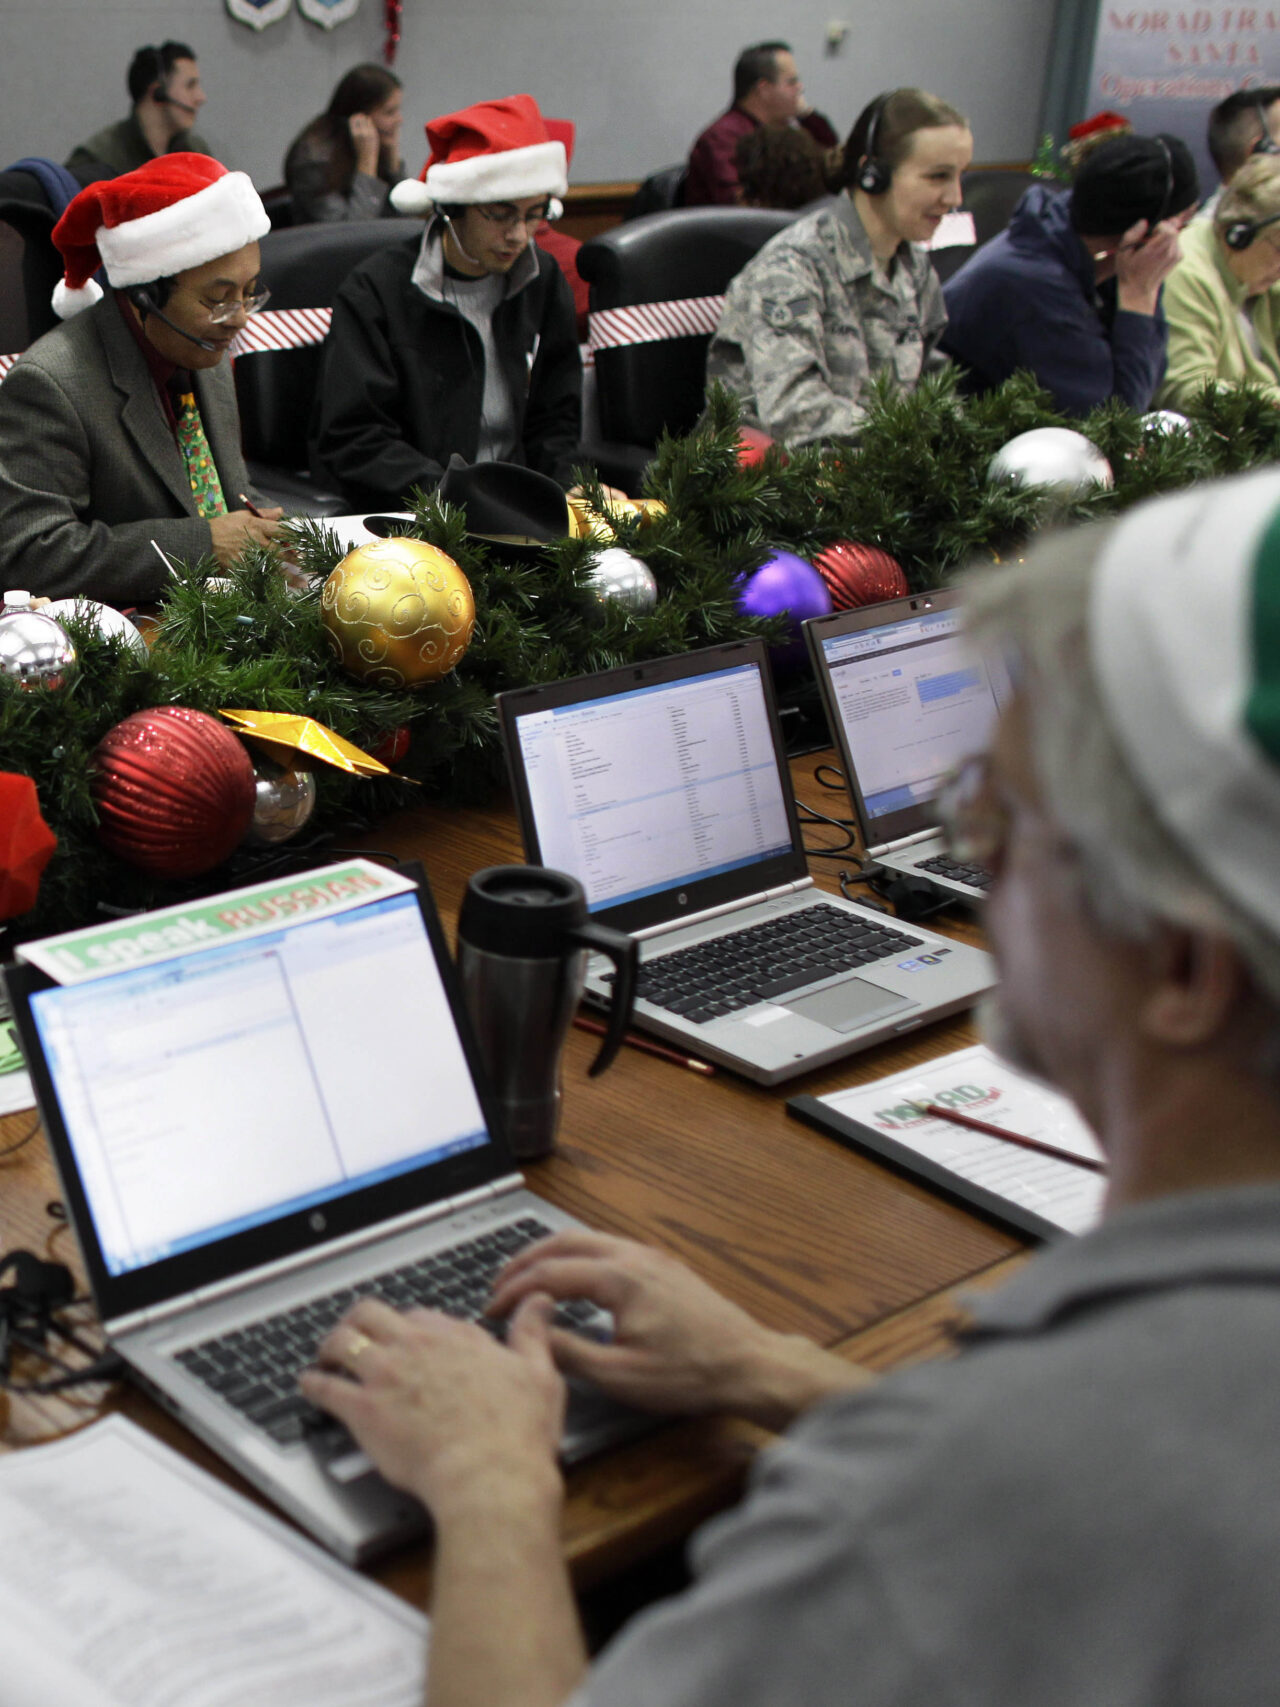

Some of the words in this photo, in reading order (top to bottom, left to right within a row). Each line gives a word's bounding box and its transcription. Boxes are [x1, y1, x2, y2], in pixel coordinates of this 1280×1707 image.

[1106, 8, 1212, 33] NORAD
[1167, 41, 1260, 66] SANTA
[86, 917, 221, 965] speak
[218, 872, 384, 930] RUSSIAN
